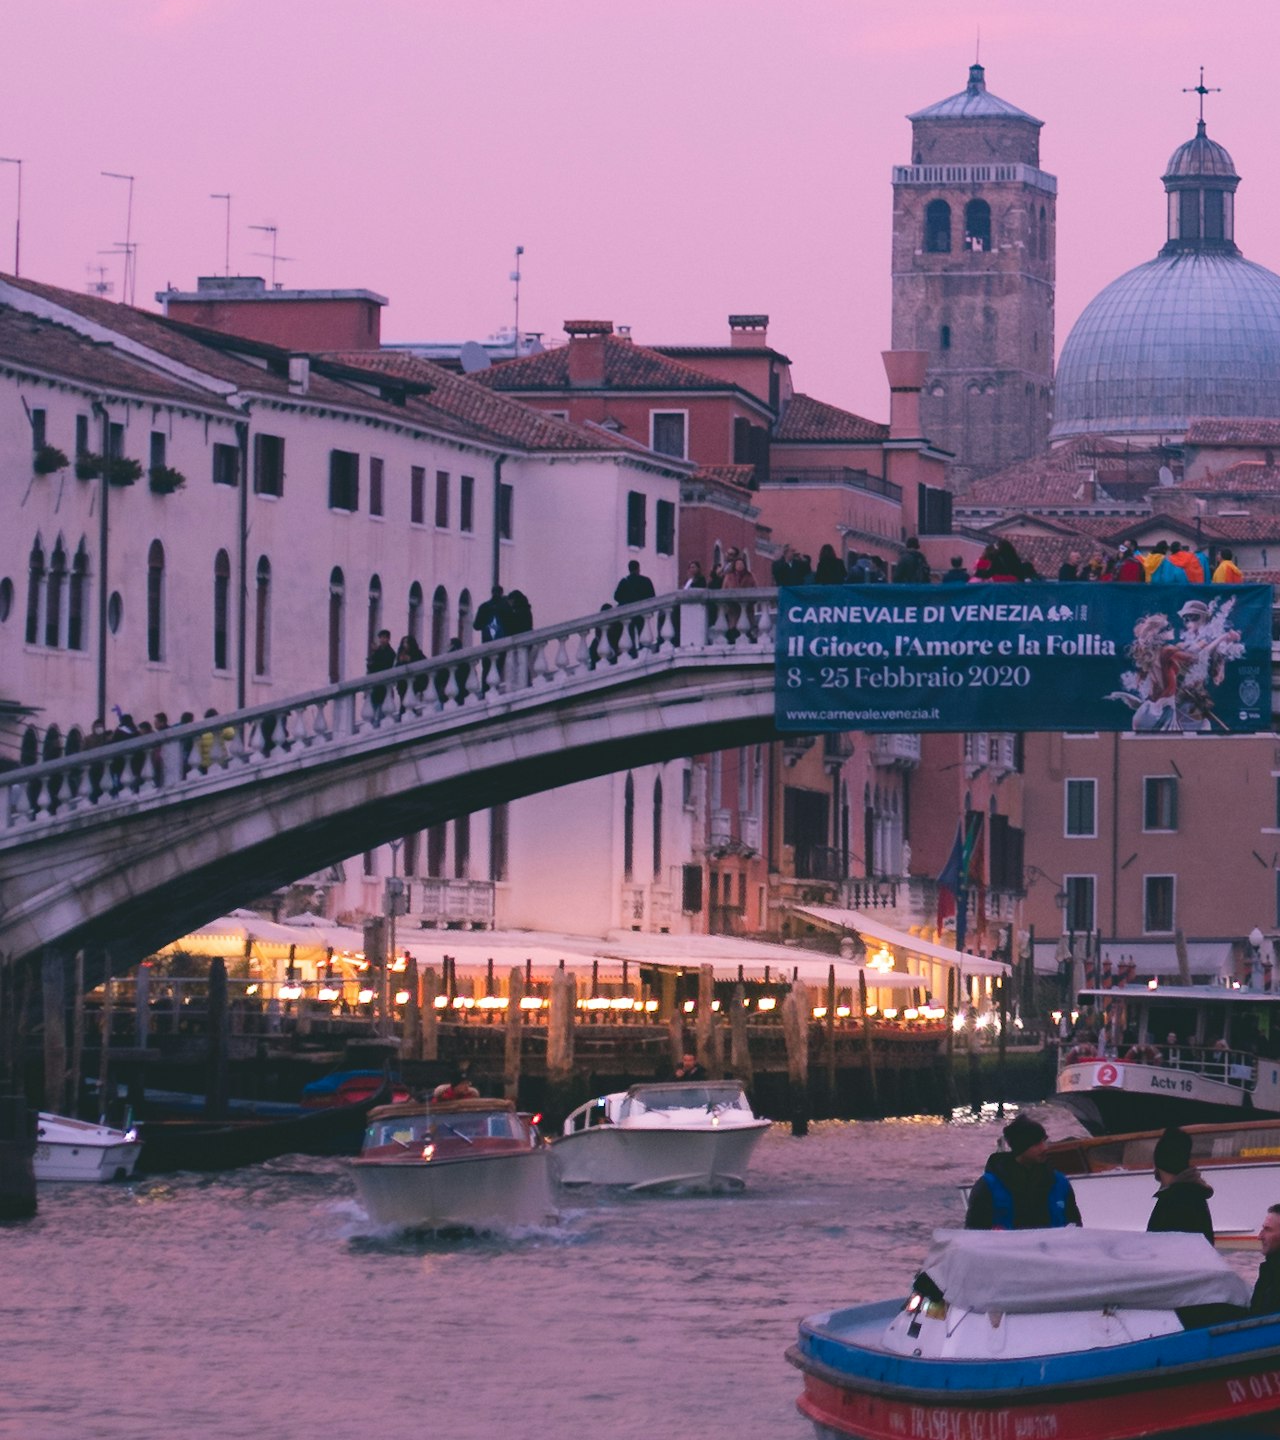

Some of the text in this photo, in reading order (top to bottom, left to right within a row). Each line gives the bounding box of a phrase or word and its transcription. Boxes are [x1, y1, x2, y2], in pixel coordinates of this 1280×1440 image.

[788, 604, 1044, 623] CARNEVALE DI VENEZIA
[787, 634, 1115, 660] Il Gioco, l'Amore e la Follia
[786, 667, 802, 688] 8
[820, 667, 849, 688] 25
[855, 665, 963, 688] Febbraio
[968, 665, 1031, 687] 2020
[786, 708, 940, 720] www.carnevale.venezia.it
[1103, 1068, 1112, 1081] 2
[1150, 1075, 1193, 1092] Actv 16
